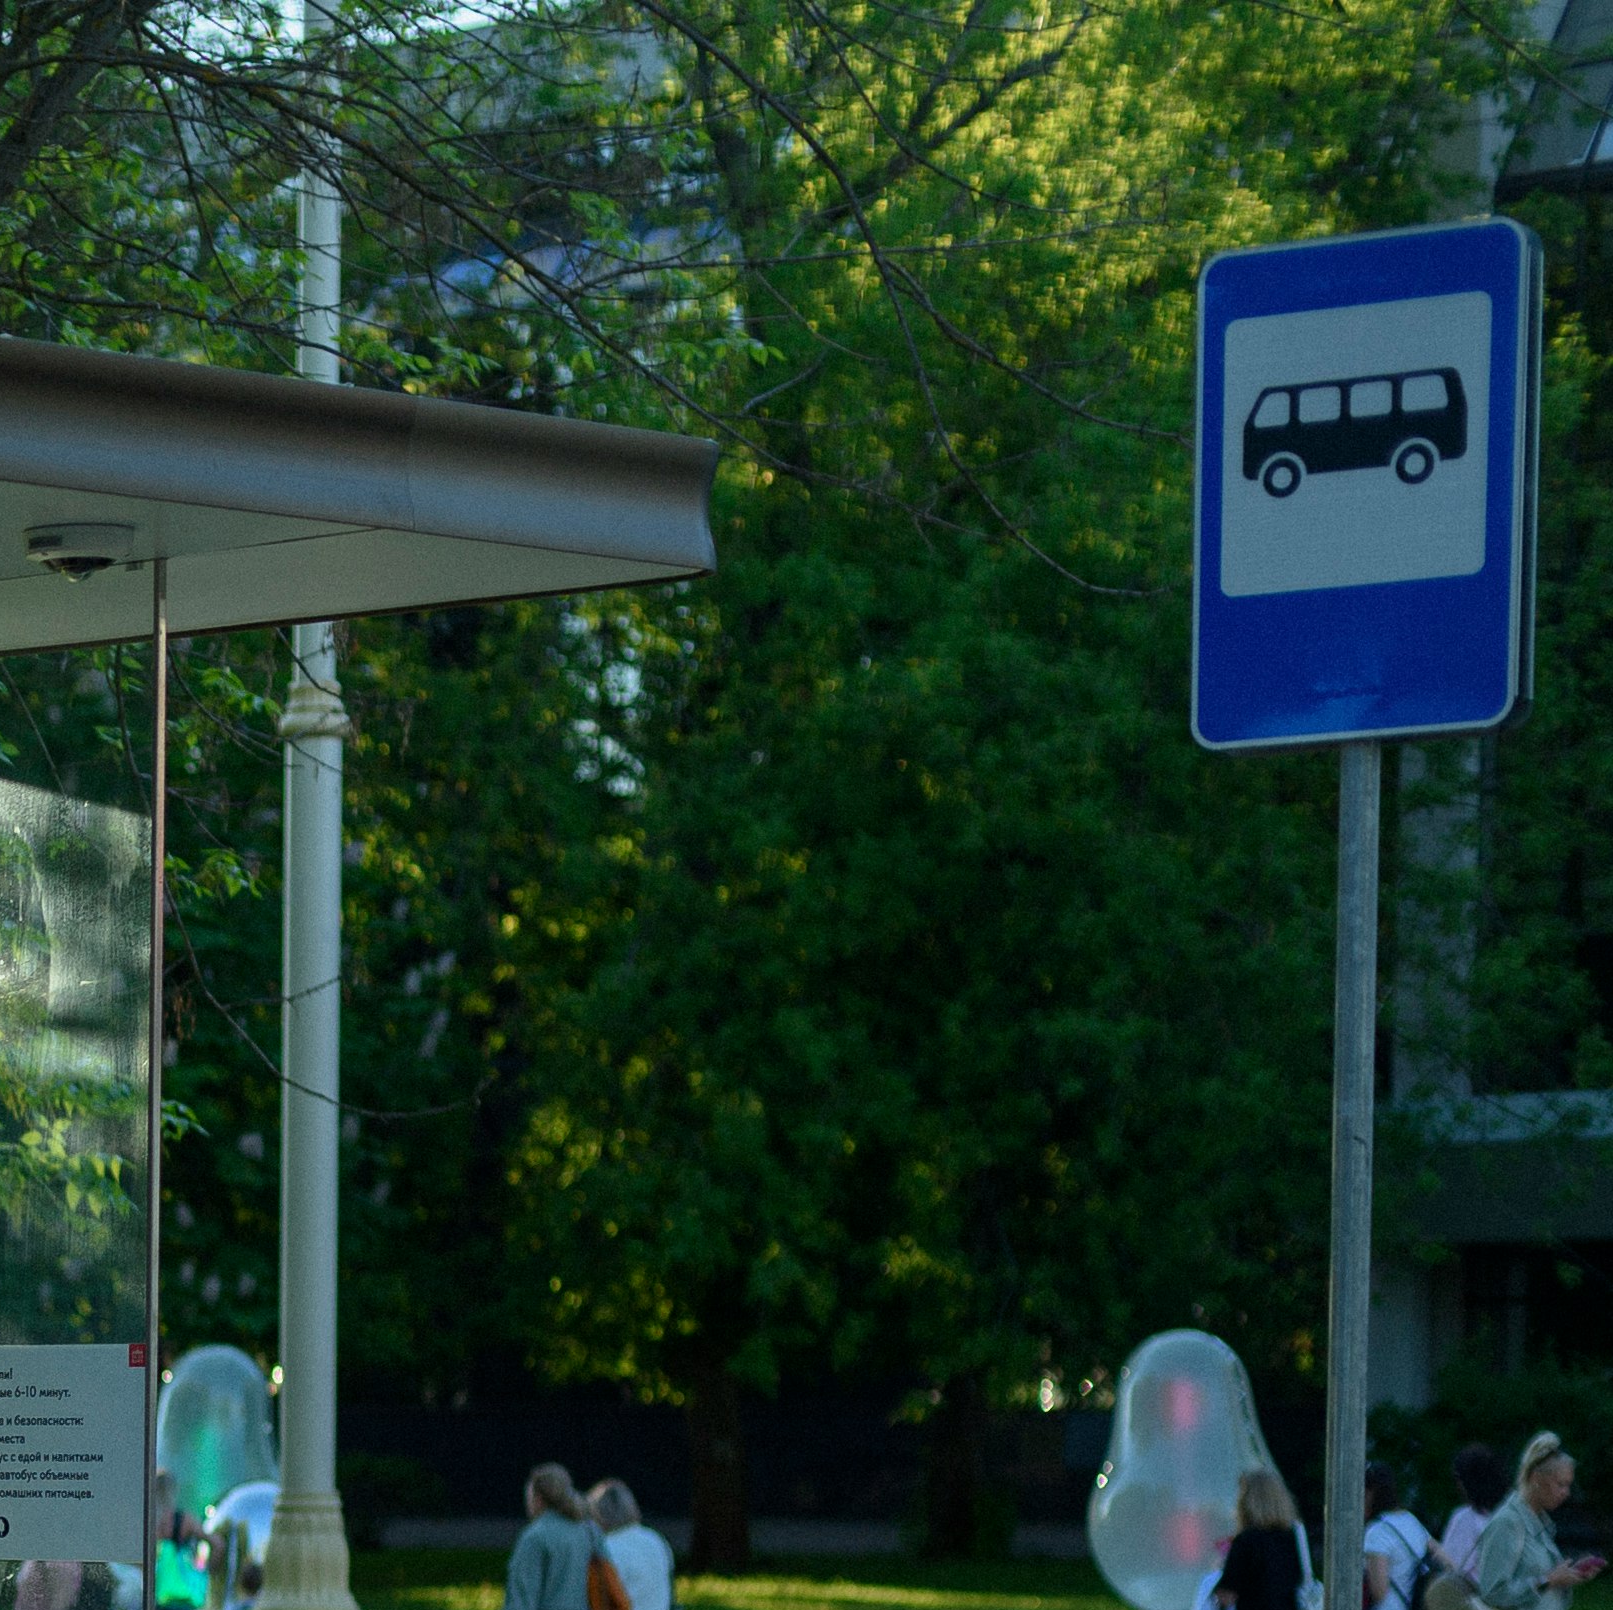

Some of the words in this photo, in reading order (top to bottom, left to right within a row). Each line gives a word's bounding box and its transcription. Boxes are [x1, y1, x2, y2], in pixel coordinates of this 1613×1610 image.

[14, 1385, 37, 1398] 6-10
[39, 1388, 71, 1400] минут.
[6, 1417, 12, 1426] и
[14, 1415, 84, 1426] безопасности:
[10, 1453, 16, 1462] с
[18, 1451, 41, 1464] едой
[43, 1453, 50, 1462] и
[52, 1453, 103, 1462] напитками
[0, 1468, 37, 1483] автобус
[39, 1469, 89, 1480] объемные
[45, 1489, 94, 1500] питомцев.
